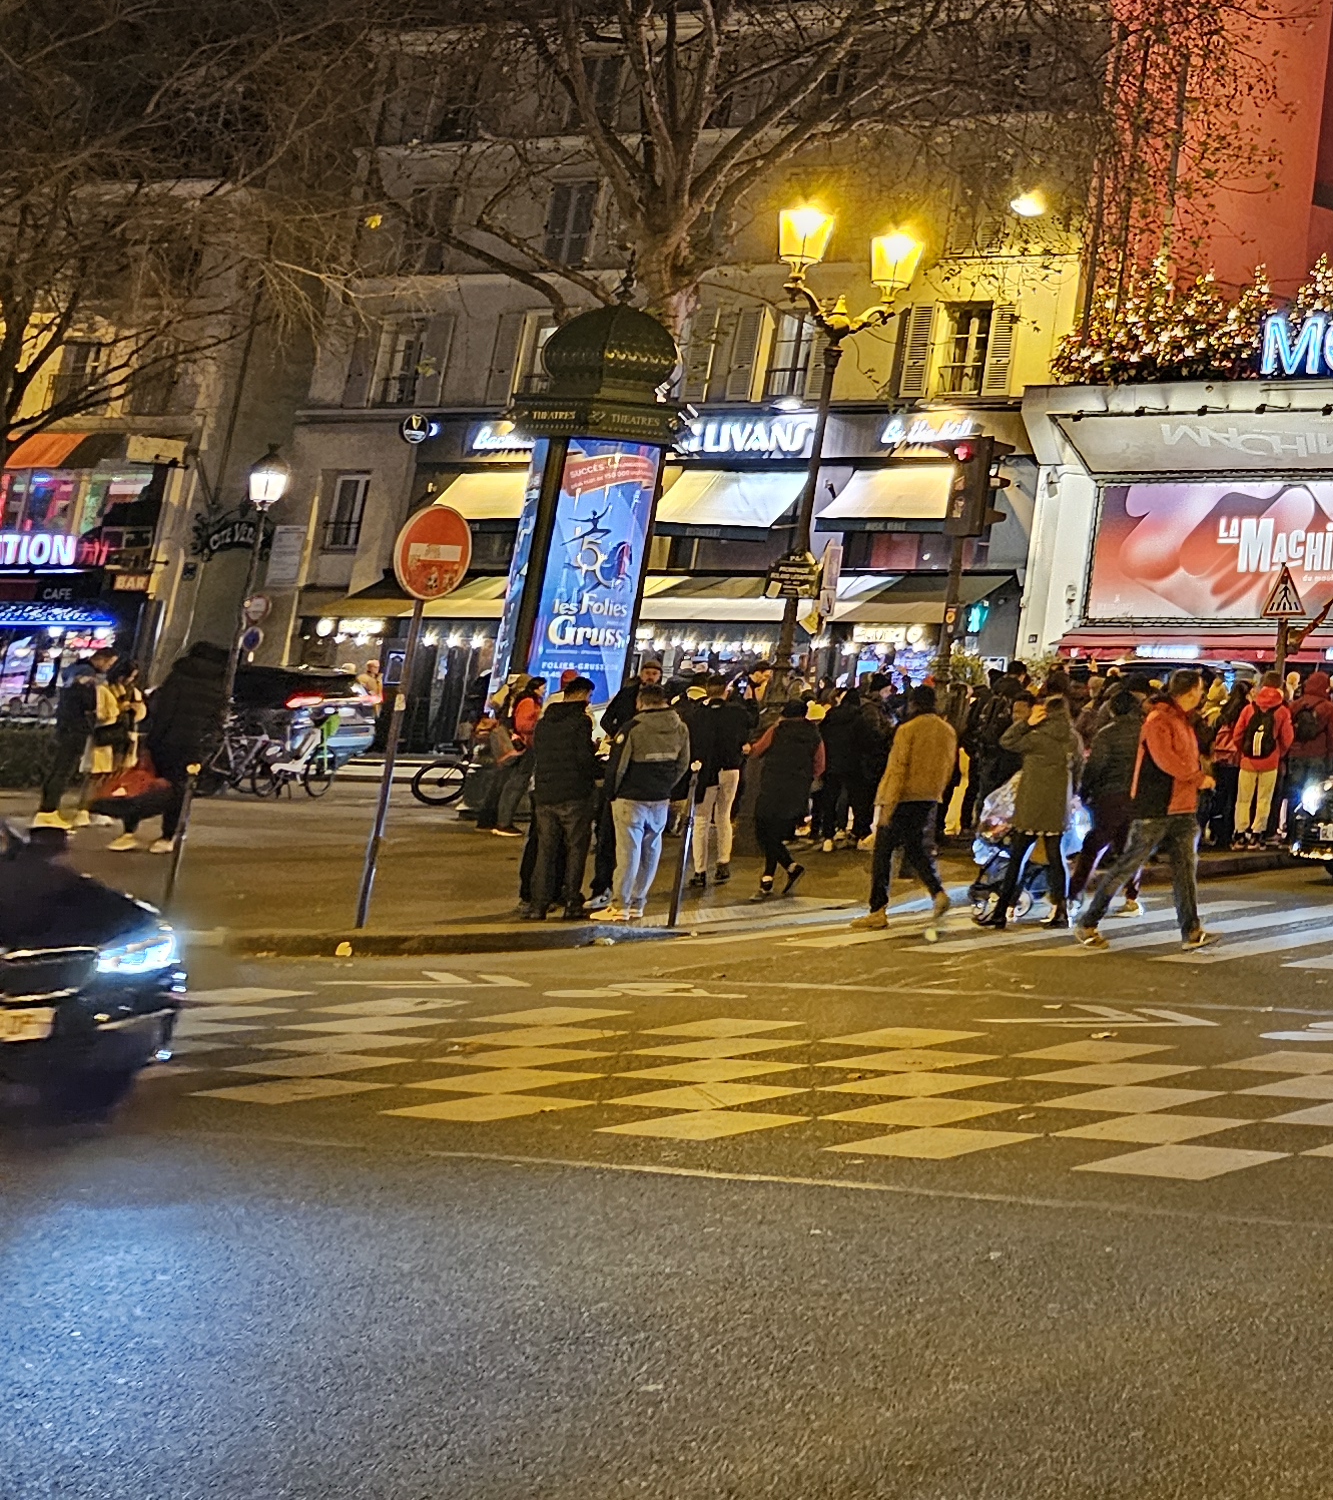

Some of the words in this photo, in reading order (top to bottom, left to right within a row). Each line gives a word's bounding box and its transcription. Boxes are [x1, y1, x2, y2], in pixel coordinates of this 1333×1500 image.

[1219, 517, 1239, 543] LA
[0, 533, 77, 566] TION
[115, 575, 148, 590] BAR
[553, 598, 579, 614] les
[579, 592, 628, 617] Folies
[548, 615, 625, 647] Gruss
